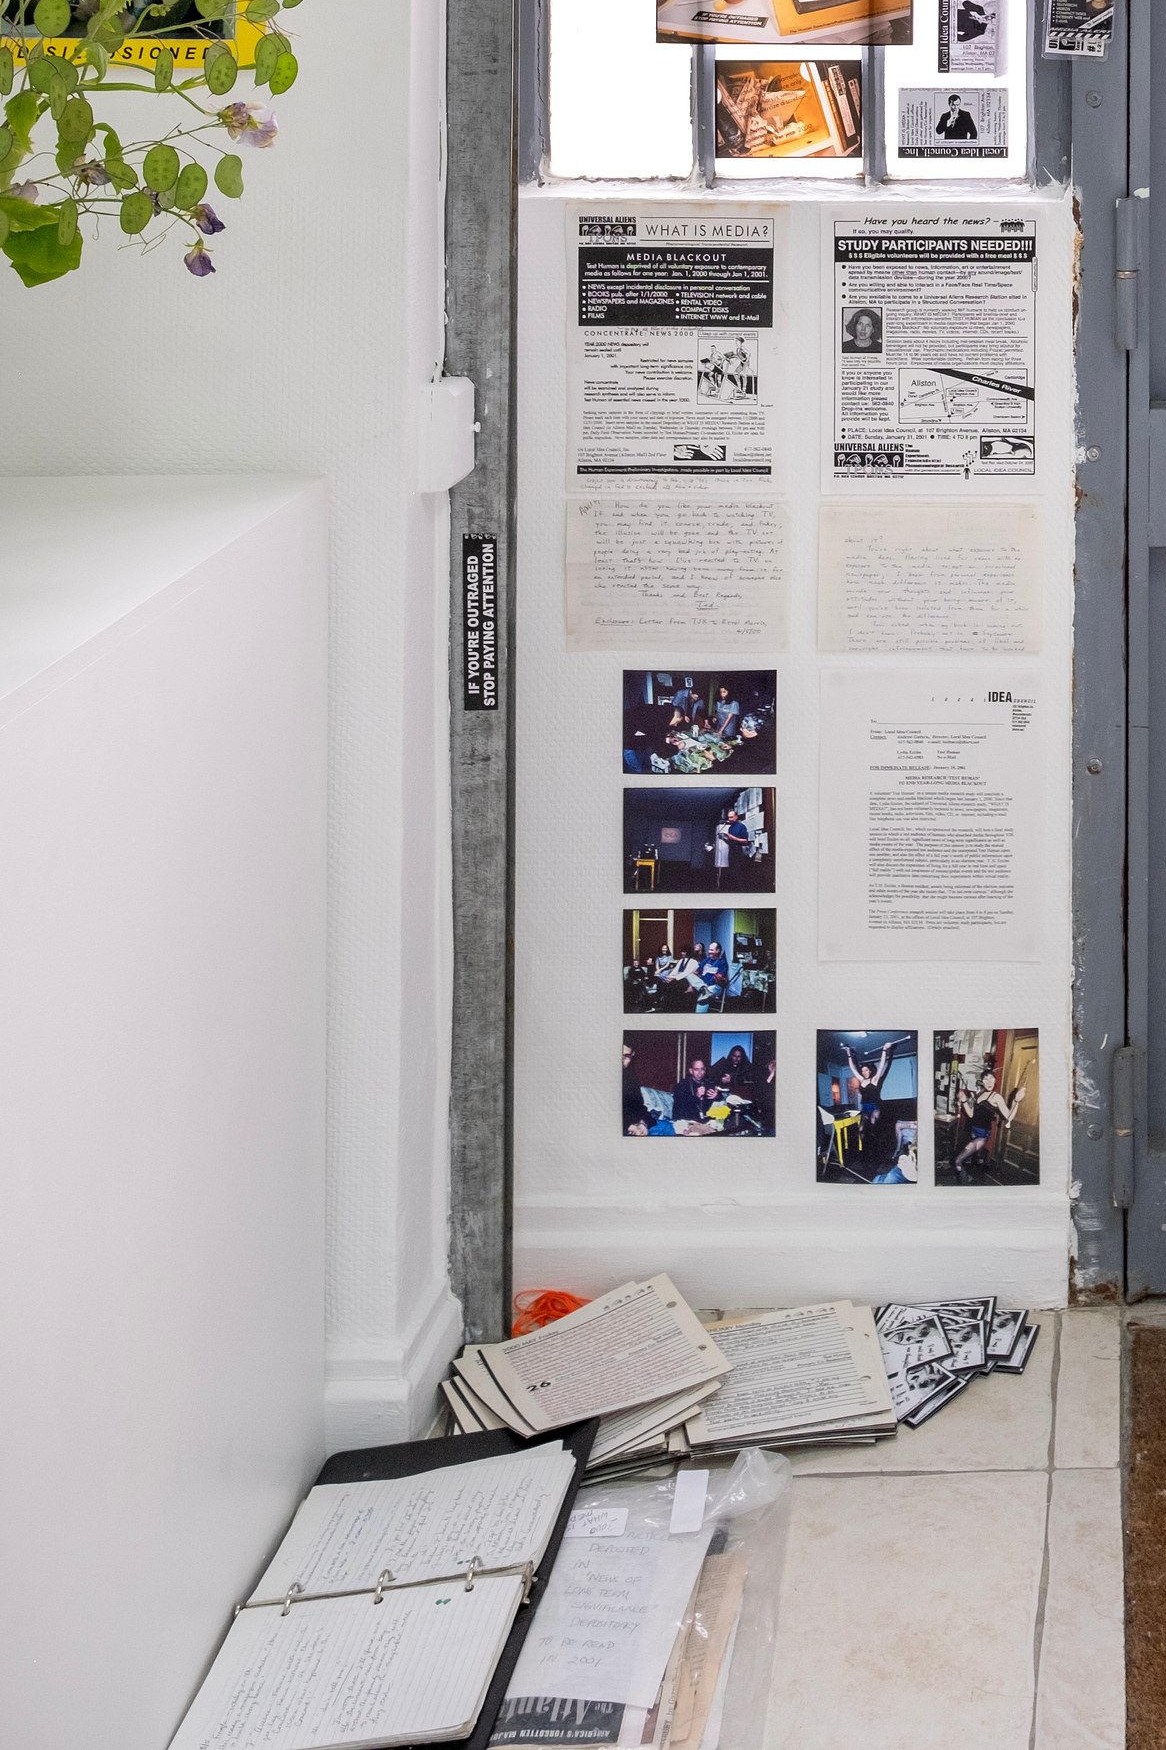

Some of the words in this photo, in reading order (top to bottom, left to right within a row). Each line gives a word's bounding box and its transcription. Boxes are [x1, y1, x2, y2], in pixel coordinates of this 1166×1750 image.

[940, 25, 949, 43] Idea
[940, 46, 949, 72] Local
[903, 147, 919, 157] Inc.
[922, 147, 959, 157] Council,
[961, 147, 979, 157] Idea
[982, 147, 1007, 157] Local
[864, 216, 888, 225] Have
[891, 218, 908, 227] you
[911, 216, 940, 225] heard
[943, 216, 959, 225] the
[962, 217, 991, 225] news?
[645, 224, 689, 236] WHAT
[694, 224, 707, 237] IS
[712, 225, 769, 237] MEDIA?
[838, 240, 879, 251] STUDY
[881, 240, 968, 251] PARTICIPANTS
[971, 240, 1033, 251] NEEDED!!!
[626, 253, 663, 261] MEDIA
[666, 253, 727, 262] BLACKOUT
[626, 262, 651, 271] deprived
[667, 263, 694, 271] voluntary
[728, 264, 767, 272] contemporary
[971, 376, 1000, 389] Charles
[1001, 383, 1022, 393] River
[834, 443, 876, 451] UNIVERSAL
[878, 443, 904, 451] ALIENS
[482, 543, 494, 618] ATTENTION
[467, 555, 479, 628] OUTRAGED
[483, 621, 495, 669] PAYING
[467, 631, 480, 682] YOU'RE
[468, 682, 480, 694] IF
[483, 672, 496, 706] STOP
[988, 691, 1012, 703] IDEA
[526, 1380, 552, 1393] 26
[625, 1575, 642, 1585] OF
[594, 1702, 613, 1715] The
[519, 1729, 564, 1739] FORGOTTEN
[566, 1729, 610, 1739] AMERICA'S
